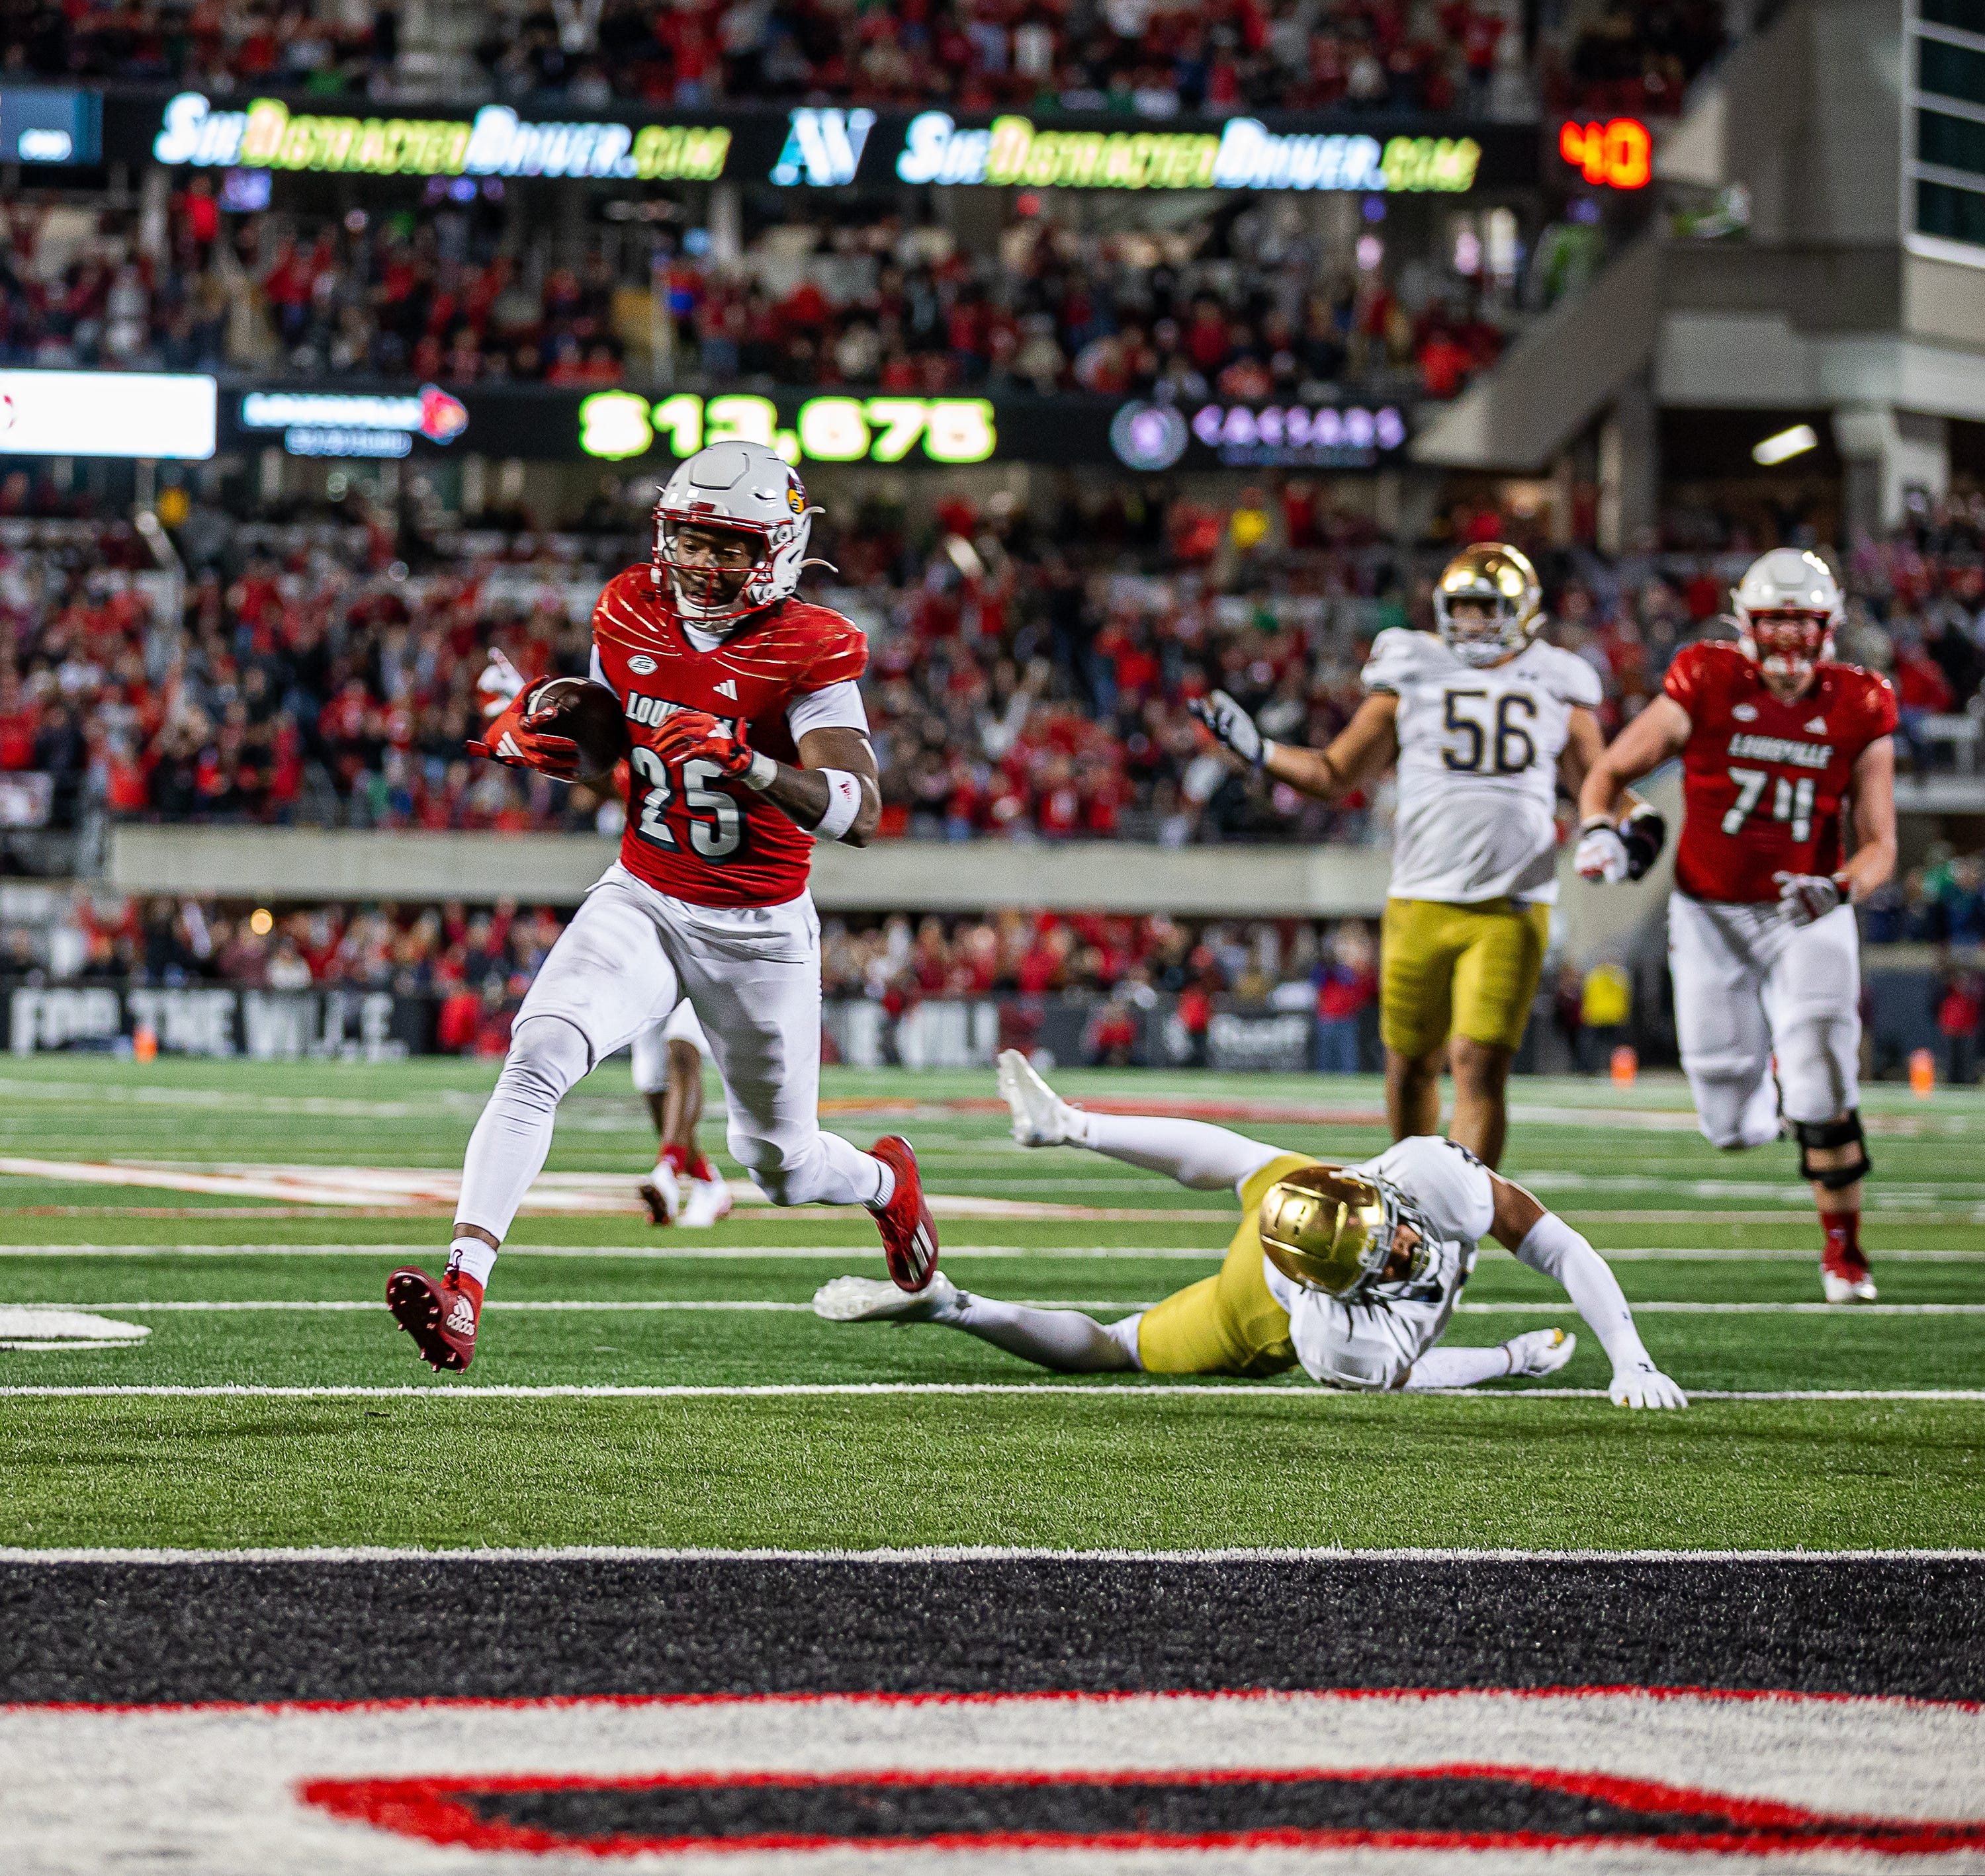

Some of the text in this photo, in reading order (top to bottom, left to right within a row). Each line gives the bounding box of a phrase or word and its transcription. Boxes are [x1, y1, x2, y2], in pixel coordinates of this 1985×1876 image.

[1560, 117, 1652, 189] 40
[579, 389, 996, 465] $13,675
[1442, 689, 1538, 773] 56
[629, 746, 742, 859] 25
[1722, 765, 1816, 843] 74
